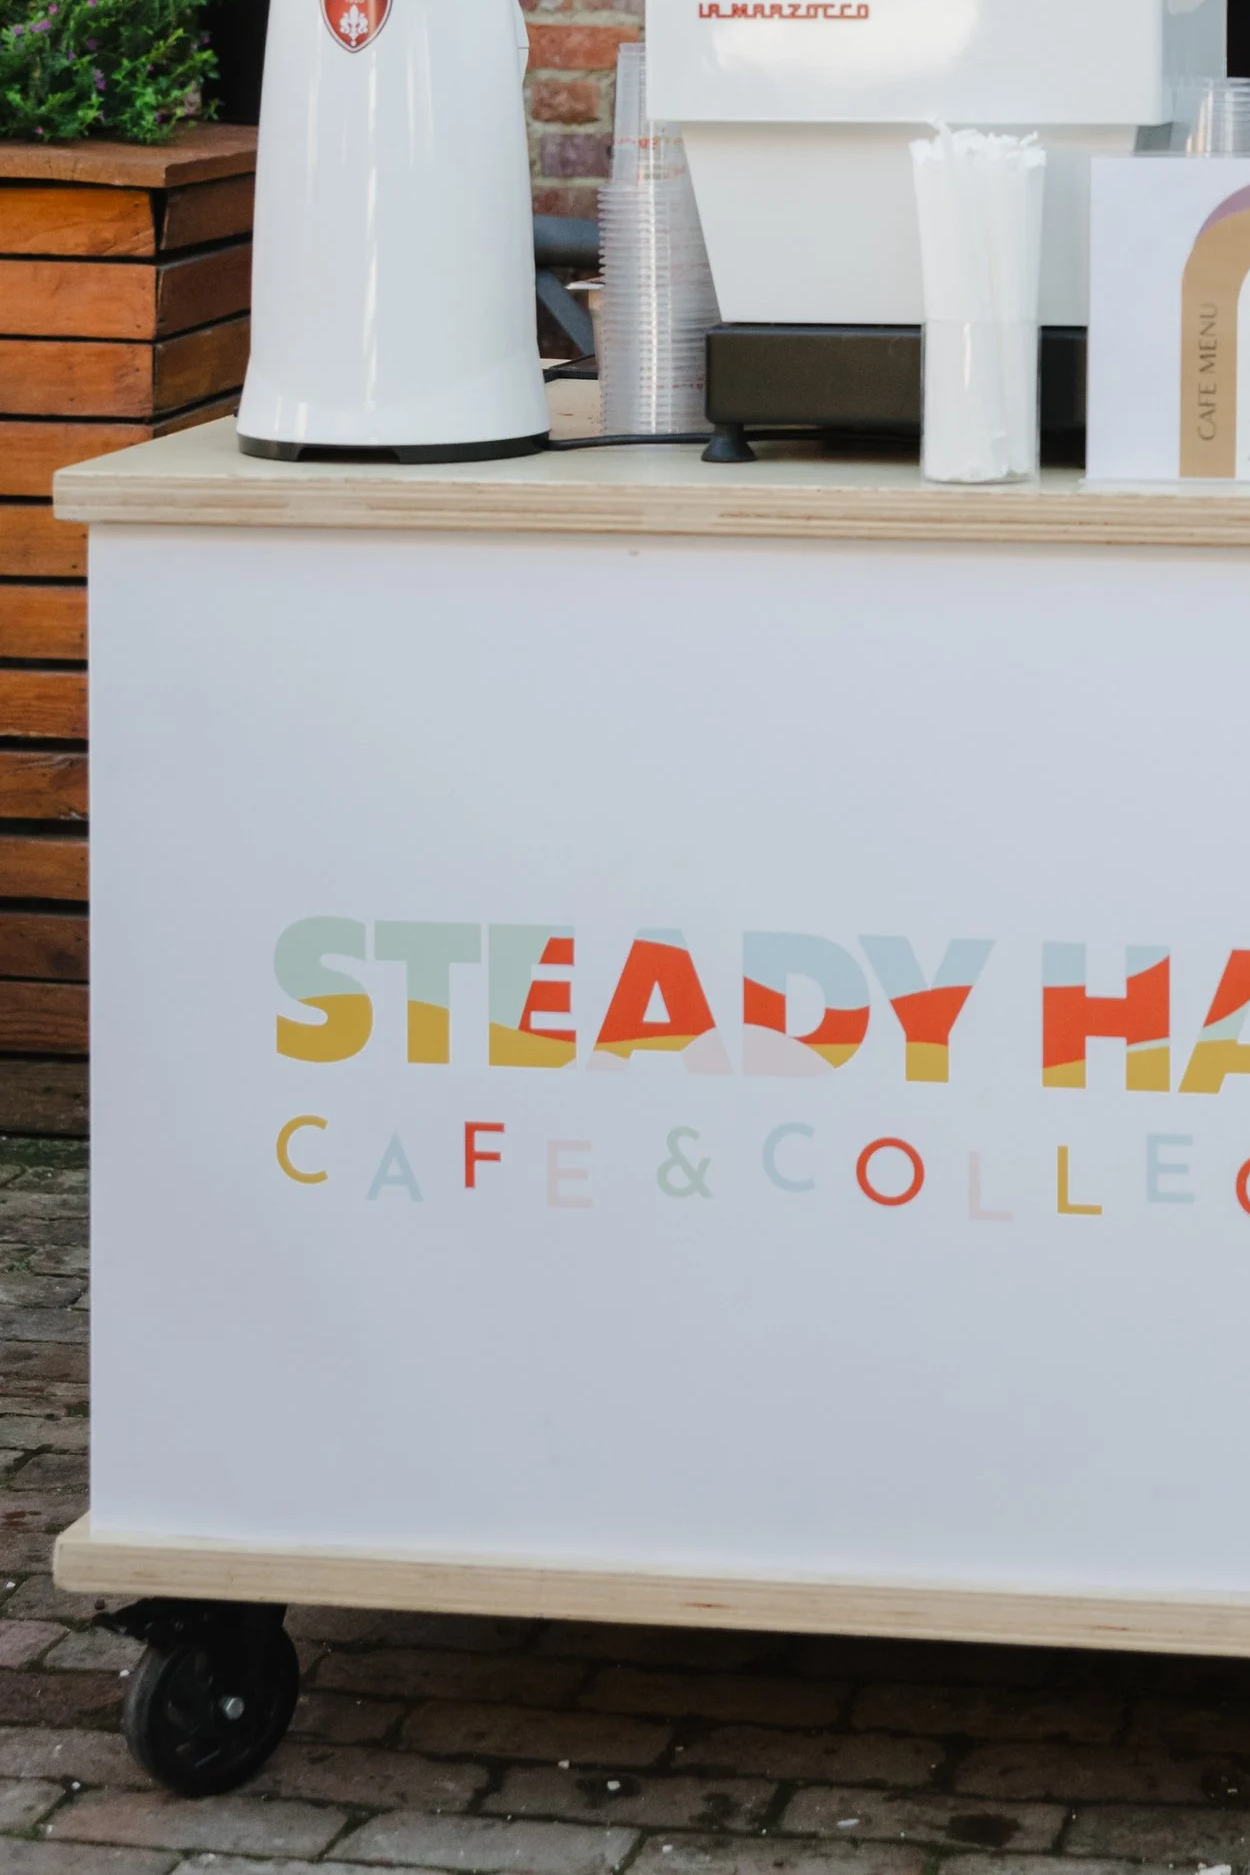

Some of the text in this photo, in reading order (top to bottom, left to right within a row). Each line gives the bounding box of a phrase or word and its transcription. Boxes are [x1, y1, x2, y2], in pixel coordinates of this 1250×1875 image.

[1197, 303, 1218, 441] CAFE MENU
[273, 915, 997, 1083] STEADY
[276, 1114, 593, 1209] CAFE
[656, 1126, 714, 1200] &
